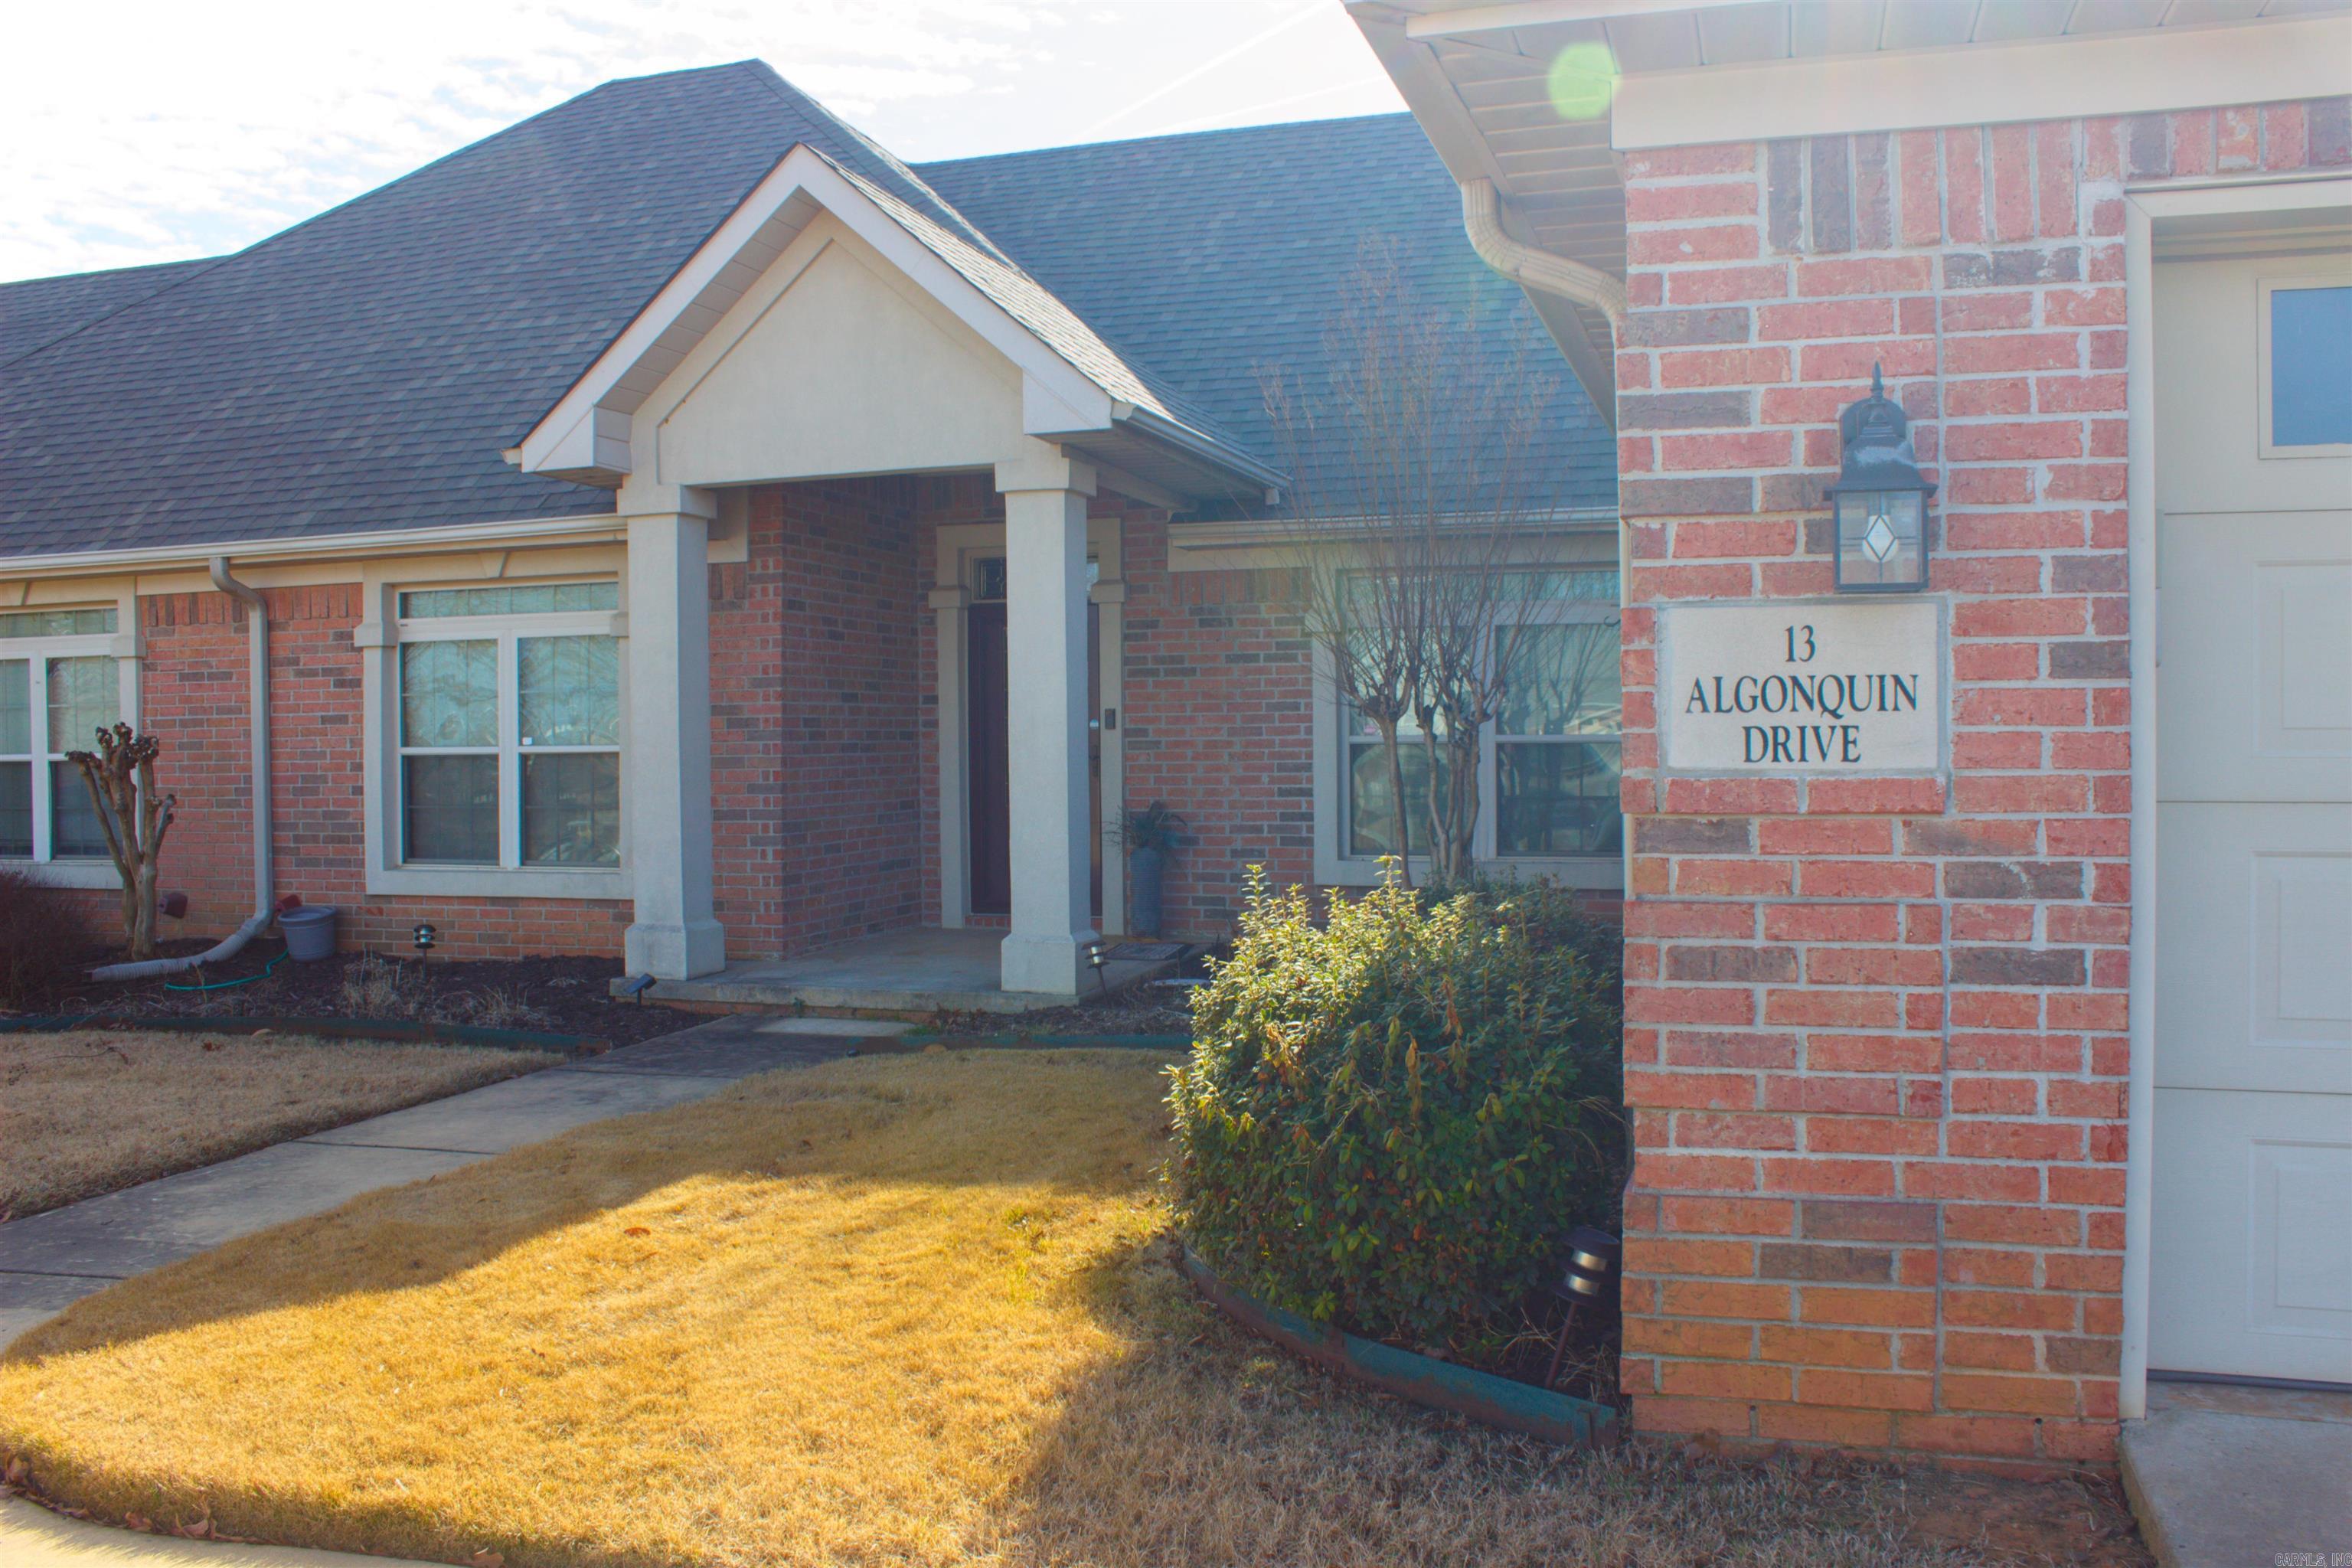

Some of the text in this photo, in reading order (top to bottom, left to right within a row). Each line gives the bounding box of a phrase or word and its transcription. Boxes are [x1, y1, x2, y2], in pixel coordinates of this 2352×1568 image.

[1785, 625, 1816, 662] 13
[1685, 674, 1919, 720] ALGONQUIN
[1742, 724, 1861, 763] DRIVE
